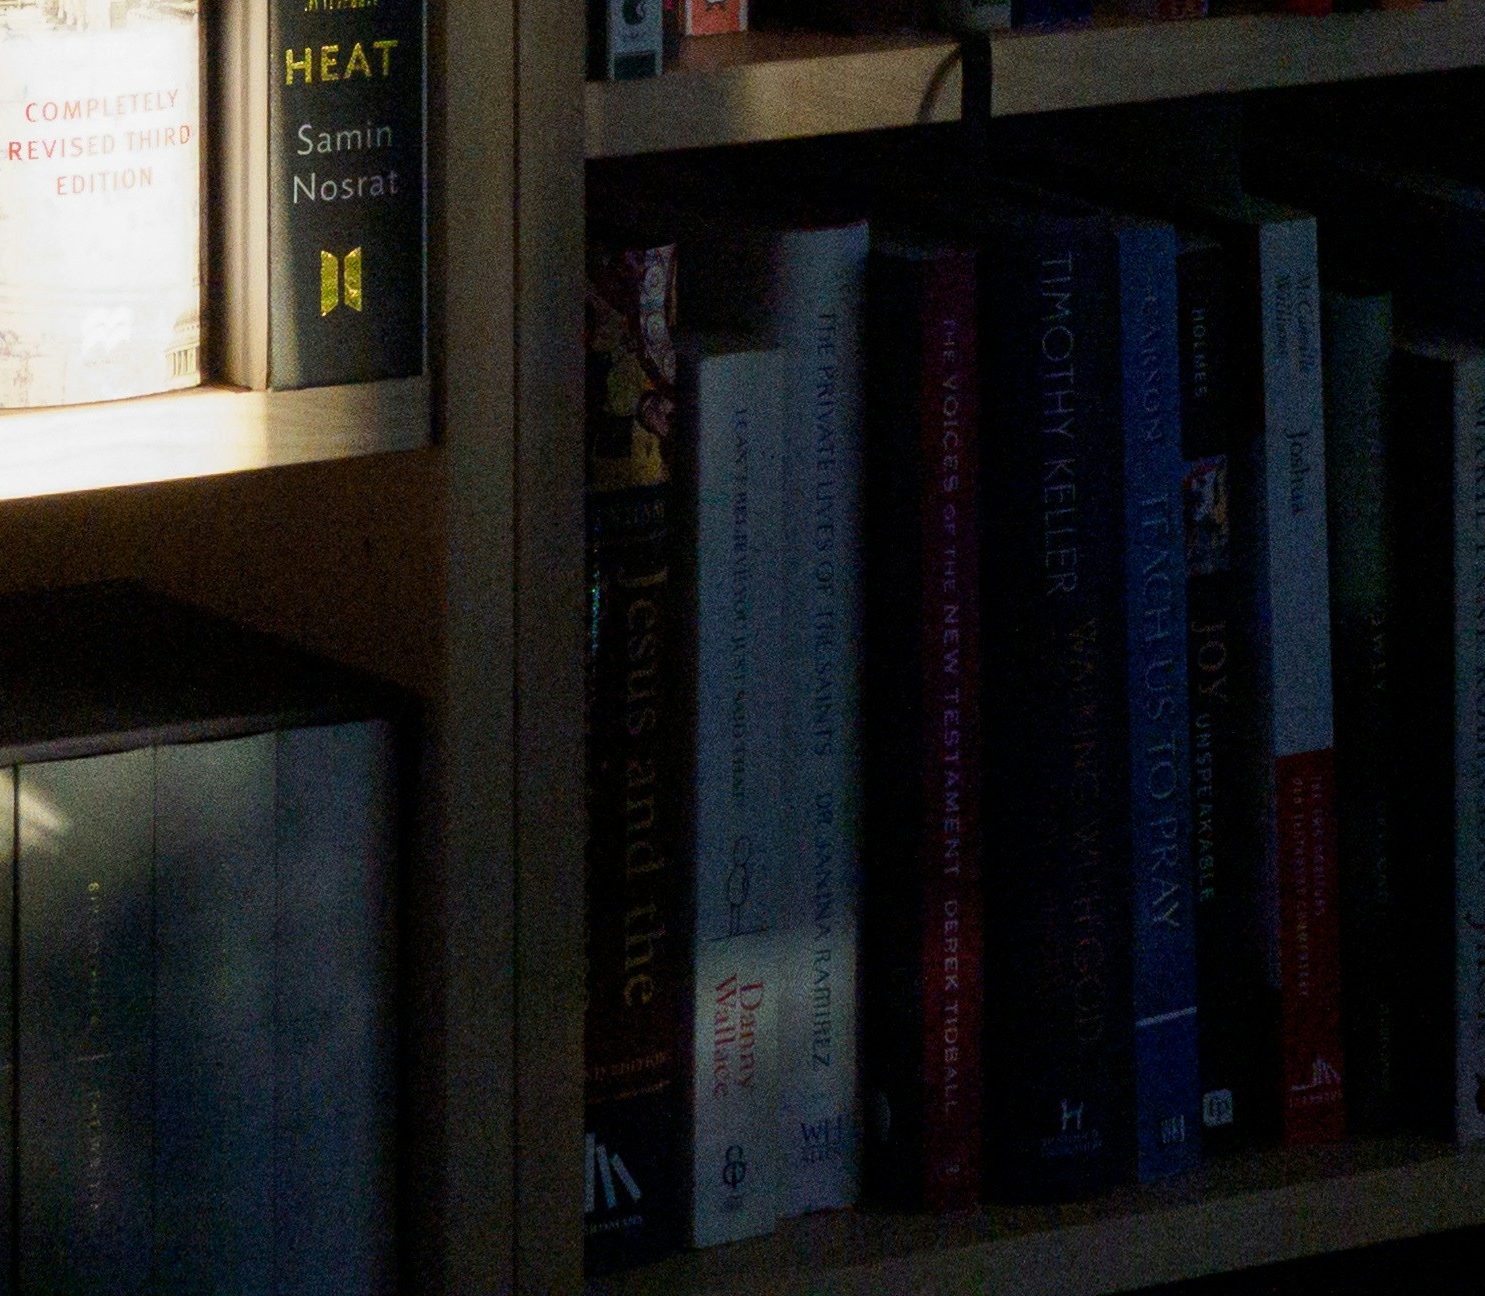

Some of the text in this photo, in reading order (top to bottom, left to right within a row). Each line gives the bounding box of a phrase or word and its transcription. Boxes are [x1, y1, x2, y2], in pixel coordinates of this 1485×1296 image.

[285, 43, 398, 86] HEAT
[24, 88, 179, 124] COMPLETELY
[6, 132, 116, 162] REVISED
[295, 124, 396, 157] Samin
[55, 166, 155, 197] EDITION
[291, 173, 400, 207] Nosrat
[1038, 251, 1079, 596] TIMOTHY KELLER
[1189, 307, 1229, 904] HOLMES JOY UNSPEAKABLE
[616, 566, 673, 1008] Jesus and the
[711, 972, 739, 1100] Wallace
[736, 979, 765, 1092] Danny
